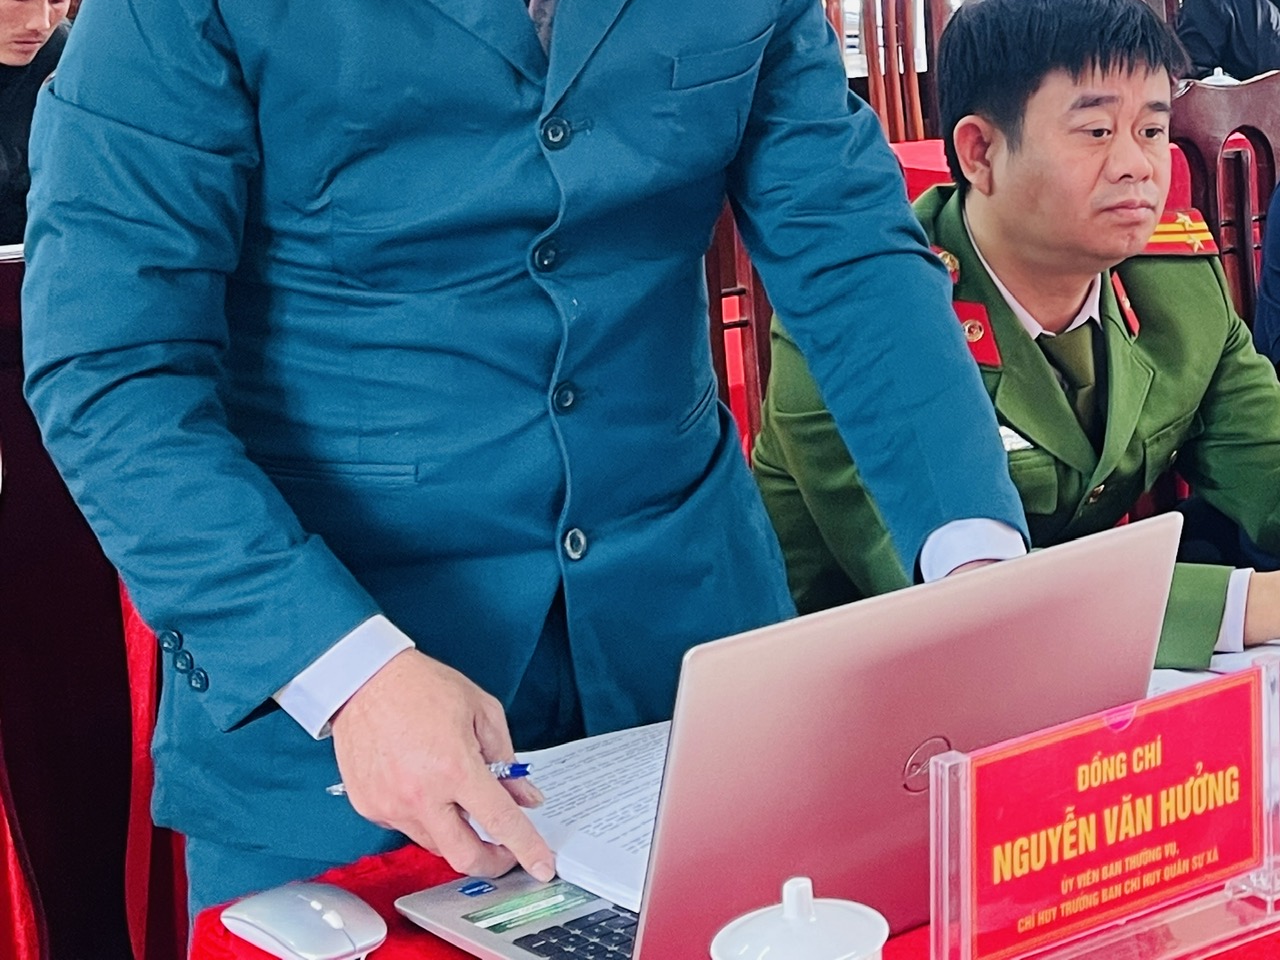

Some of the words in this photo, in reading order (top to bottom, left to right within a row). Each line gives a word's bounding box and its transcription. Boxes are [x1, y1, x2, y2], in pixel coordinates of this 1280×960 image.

[1076, 751, 1127, 792] ĐỒNG
[1132, 734, 1162, 774] CHÍ
[993, 805, 1097, 885] NGUYỄN
[1103, 793, 1153, 846] VĂN
[1160, 761, 1239, 827] HƯỞNG
[1037, 909, 1057, 927] HUY
[1101, 884, 1122, 903] BAN
[1143, 868, 1162, 889] HUY
[1101, 860, 1122, 880] BAN
